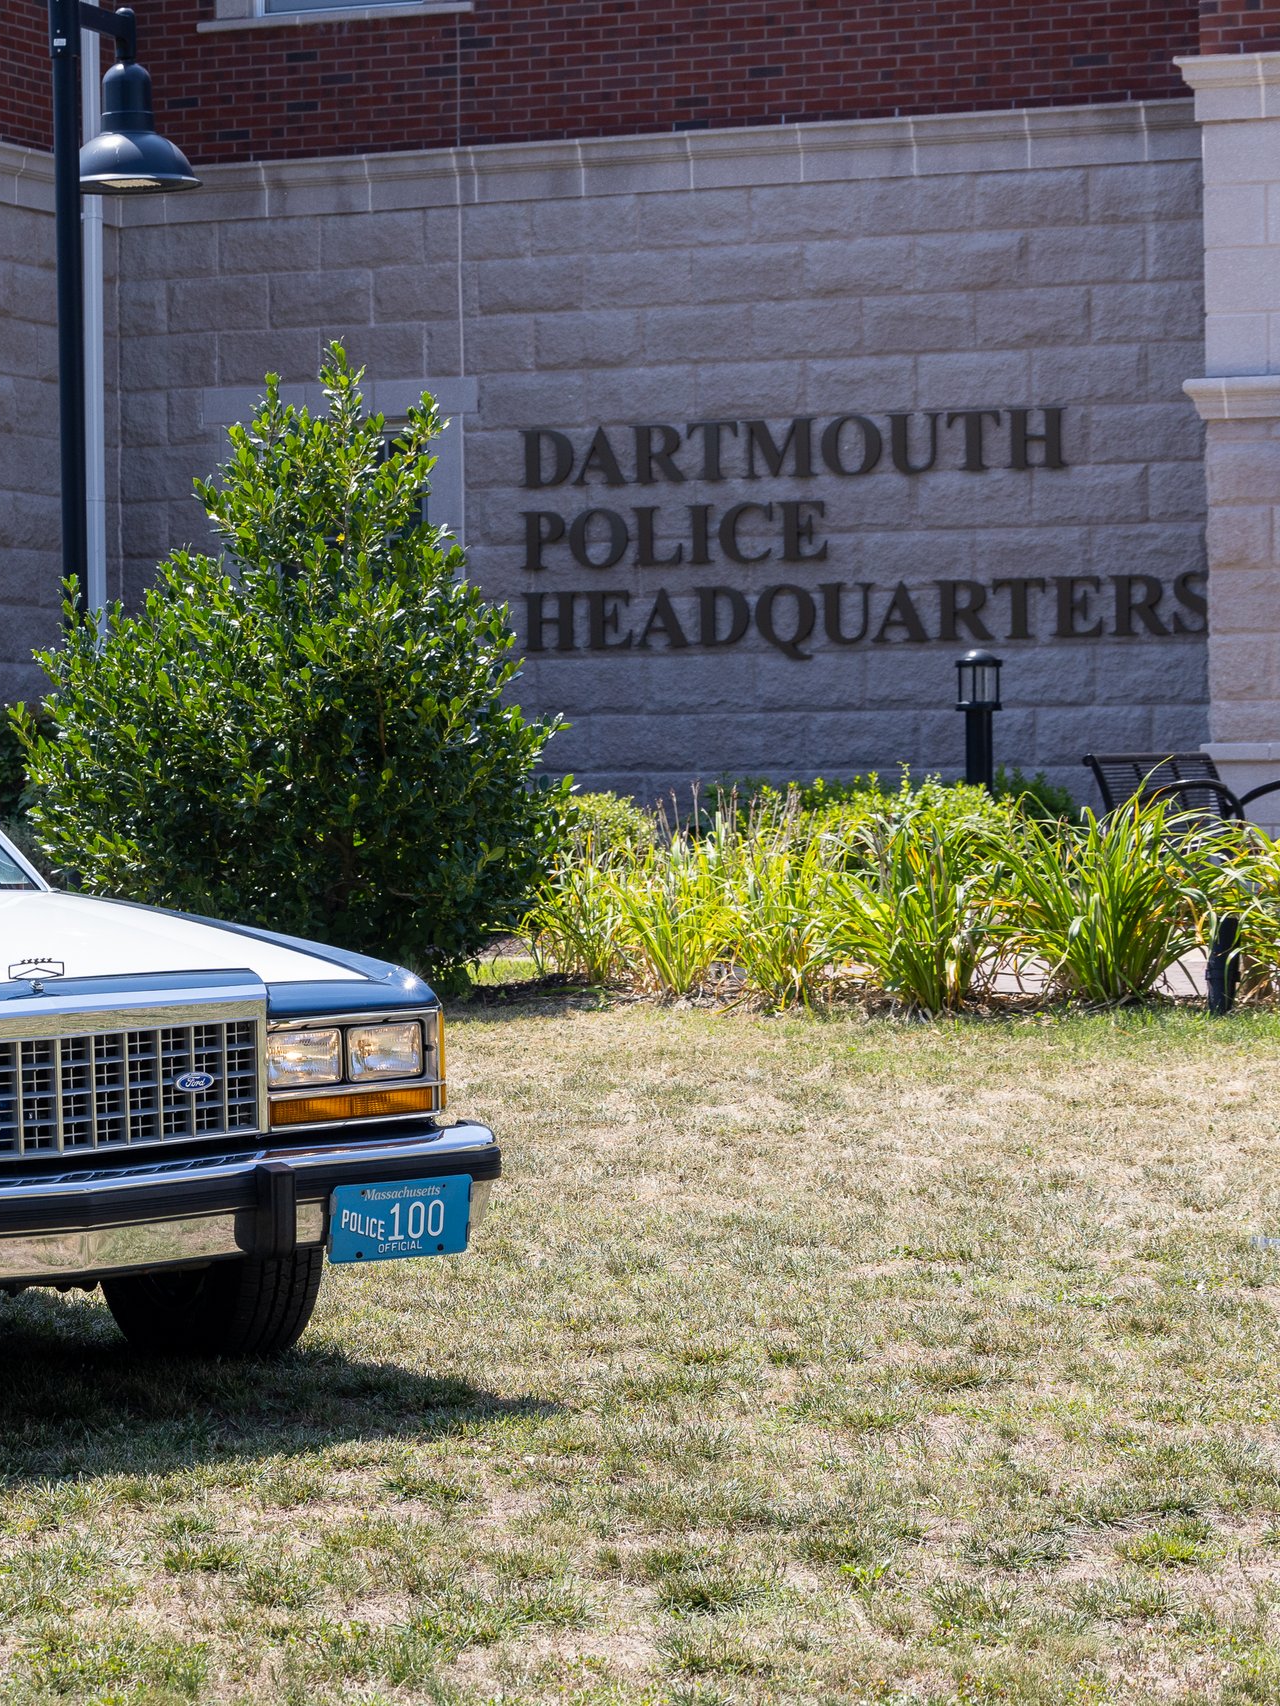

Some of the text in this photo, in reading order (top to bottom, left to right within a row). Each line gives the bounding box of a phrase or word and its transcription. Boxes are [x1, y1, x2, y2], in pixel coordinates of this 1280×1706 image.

[519, 407, 1067, 489] DARTMOUTH
[519, 500, 828, 571] POLICE
[519, 570, 1209, 660] HEADQUARTERS
[185, 1076, 206, 1088] Ford
[364, 1185, 441, 1201] Massachusetts
[341, 1200, 445, 1241] POLICE 100
[378, 1240, 422, 1254] OFFICIAL
